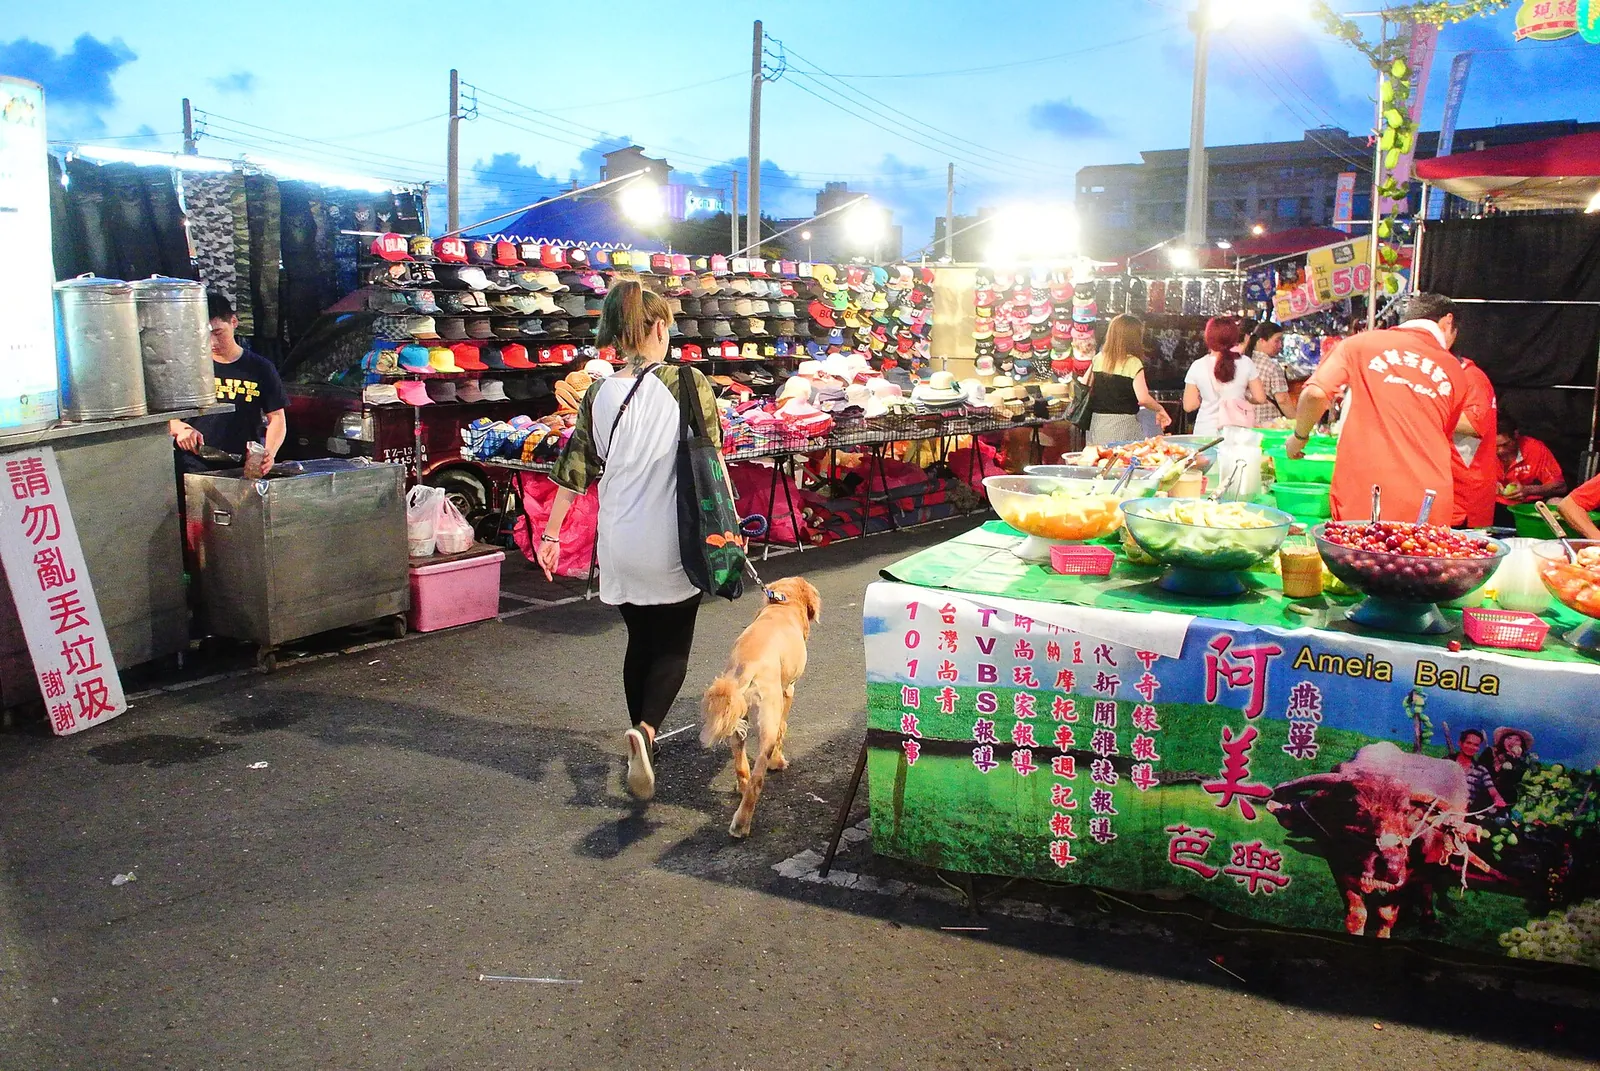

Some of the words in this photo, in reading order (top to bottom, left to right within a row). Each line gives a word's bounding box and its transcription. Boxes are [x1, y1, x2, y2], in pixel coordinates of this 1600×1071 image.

[1332, 263, 1372, 296] 50
[383, 445, 426, 458] TZ-130
[5, 456, 115, 720] 請勿亂丟垃圾
[935, 602, 960, 714] 台灣尚青
[972, 607, 1000, 773] TVBS報導
[1011, 613, 1040, 776] 時尚玩家報導
[1292, 645, 1393, 682] Ameia
[1415, 660, 1500, 696] BaLa
[41, 668, 76, 731] 謝謝
[1283, 680, 1322, 760] 燕巢
